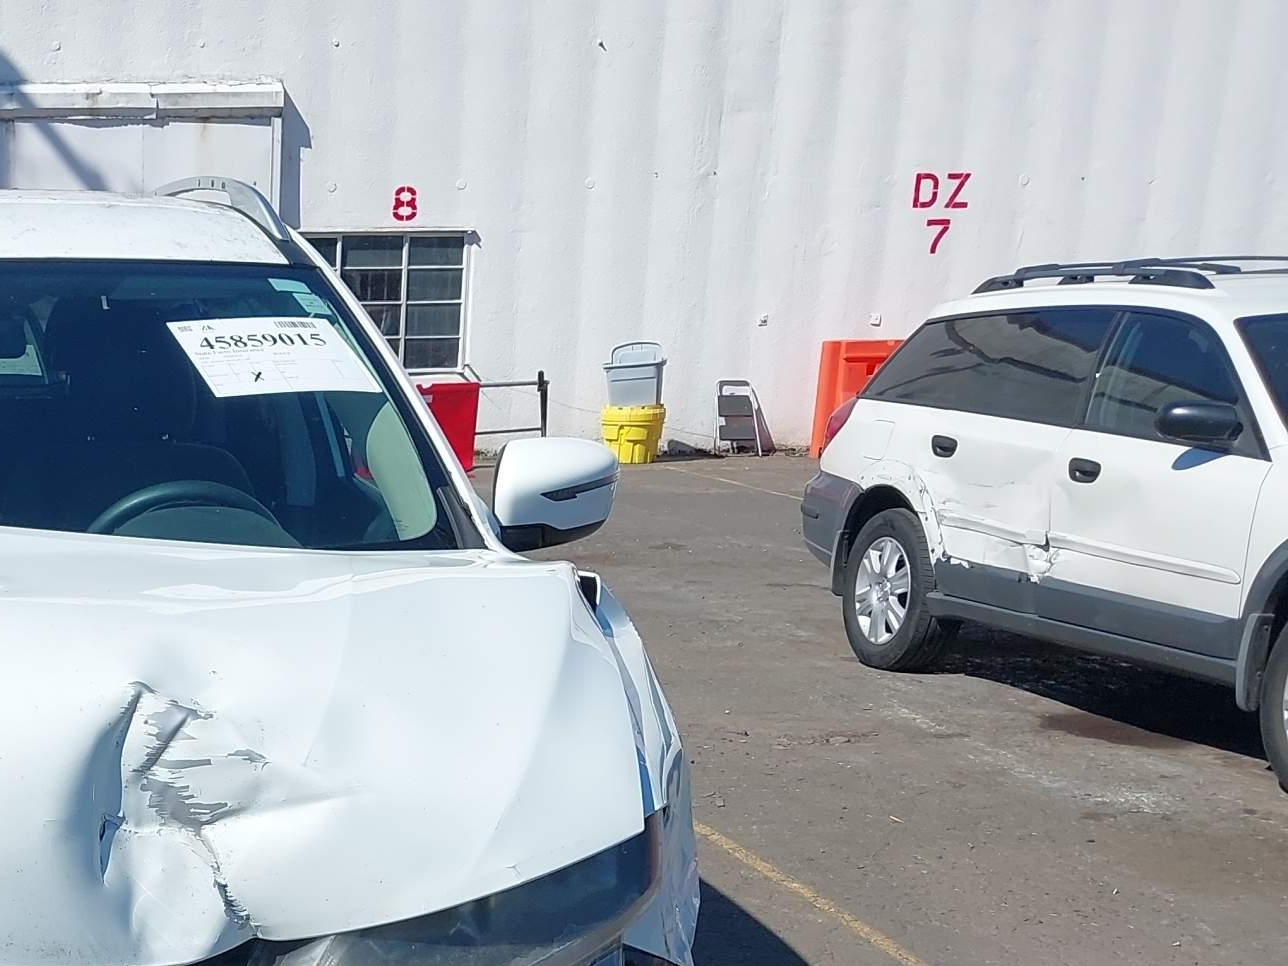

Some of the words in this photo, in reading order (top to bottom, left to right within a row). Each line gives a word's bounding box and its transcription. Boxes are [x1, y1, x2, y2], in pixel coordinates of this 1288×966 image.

[392, 186, 418, 222] 8
[912, 172, 971, 209] DZ
[926, 218, 951, 253] 7
[200, 333, 327, 350] 45859015
